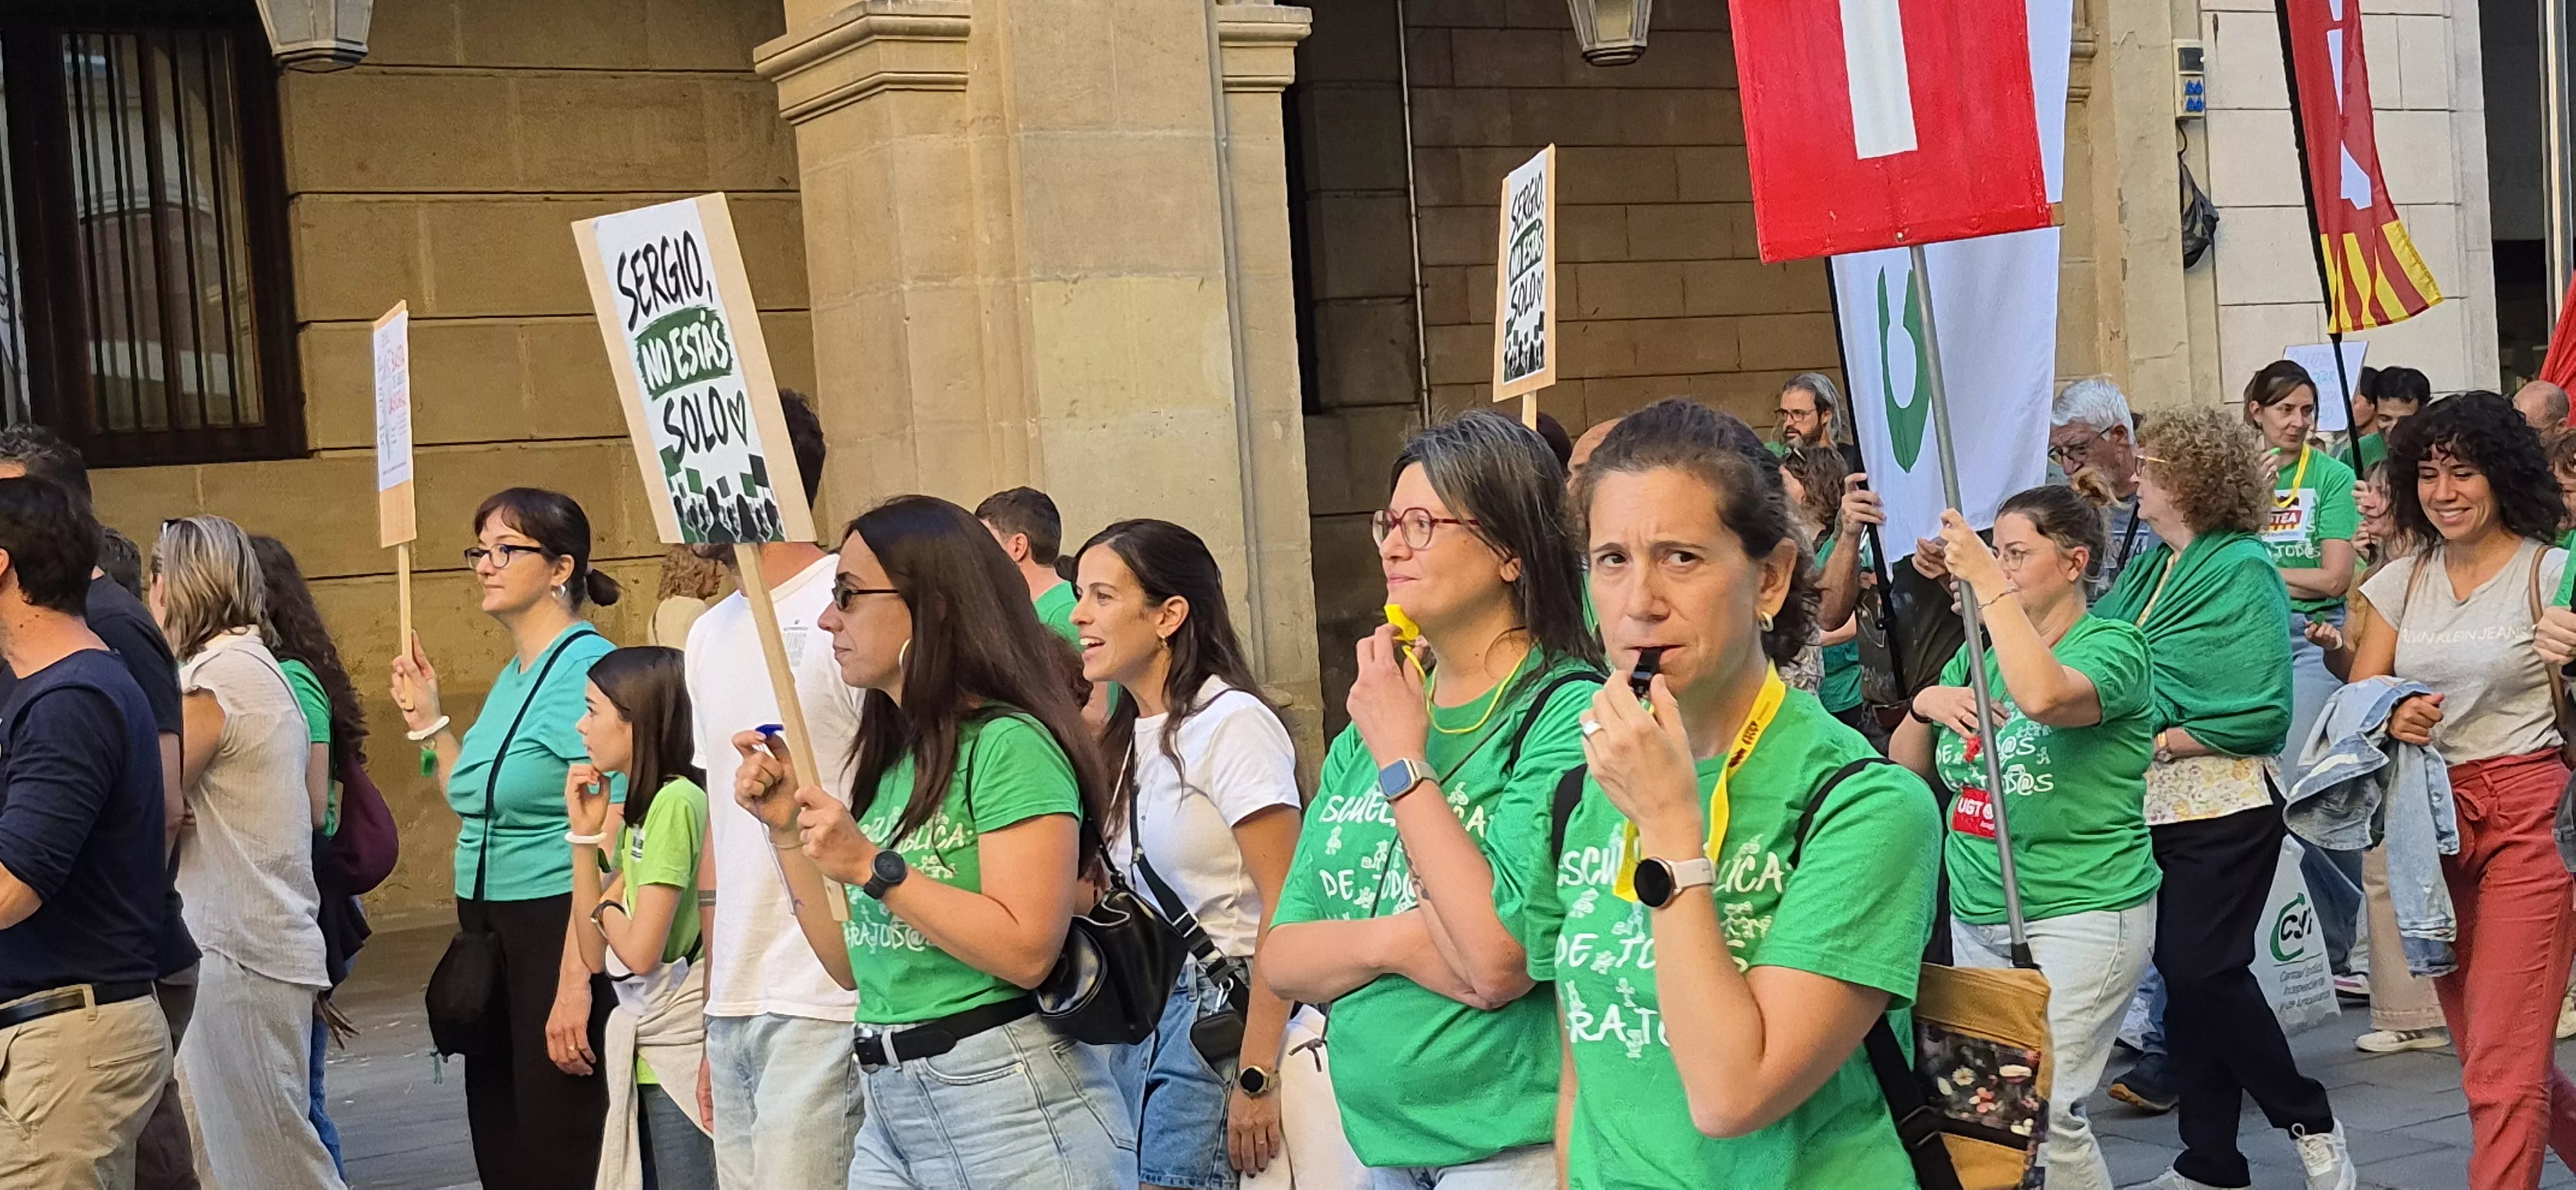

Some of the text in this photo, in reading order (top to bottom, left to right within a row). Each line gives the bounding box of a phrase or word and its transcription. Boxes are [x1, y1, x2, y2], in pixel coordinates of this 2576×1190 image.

[1511, 171, 1544, 237] SERGIO,
[616, 230, 714, 332] SERGIO,
[1511, 244, 1521, 280] NO
[1511, 272, 1536, 322] SOLO
[641, 310, 729, 391] NO ESTÁS
[663, 386, 729, 465] SOLO
[2479, 627, 2528, 640] JEANS
[1958, 797, 1984, 817] UGT
[1319, 869, 1354, 900] DE
[1555, 932, 1599, 968] DE
